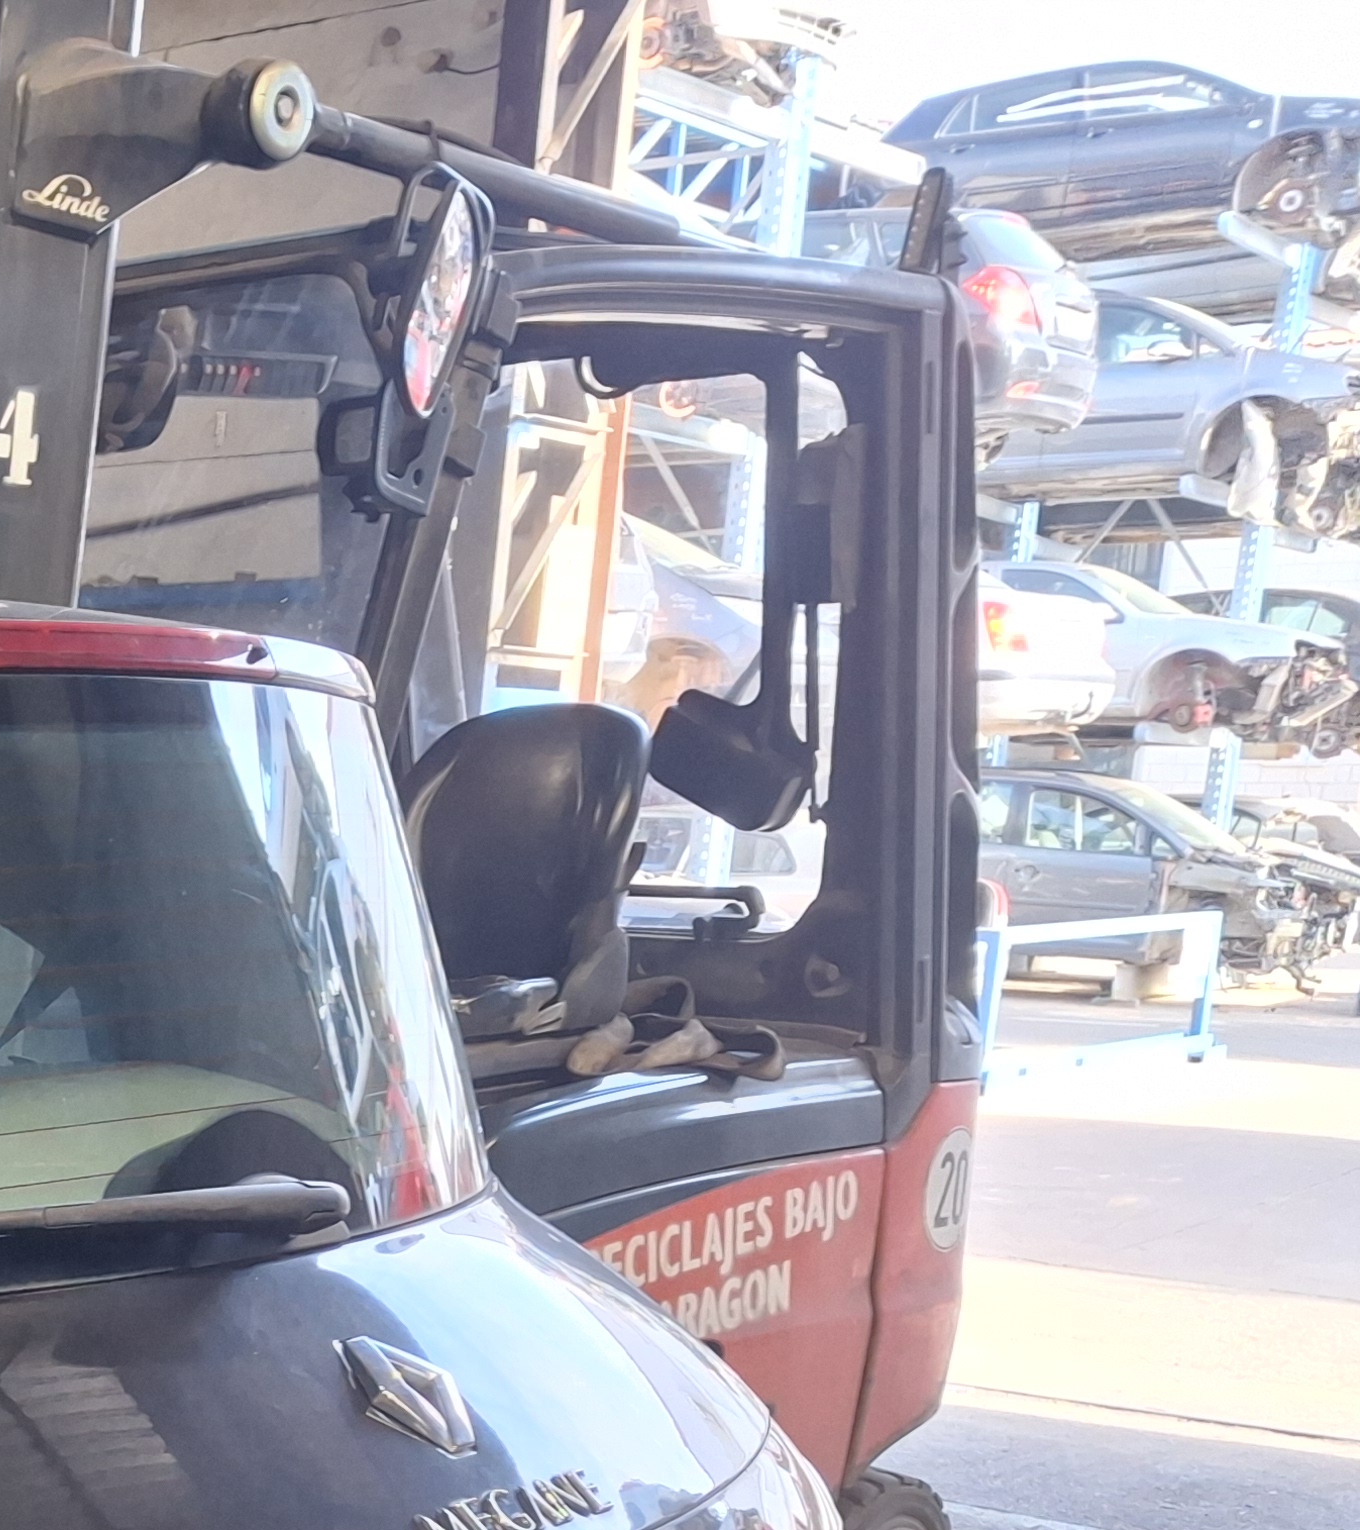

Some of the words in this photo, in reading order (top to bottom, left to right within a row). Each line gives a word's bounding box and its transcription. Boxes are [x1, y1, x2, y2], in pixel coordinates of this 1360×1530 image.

[22, 173, 110, 222] Linde
[785, 1169, 858, 1241] BAJO
[933, 1151, 968, 1228] 20
